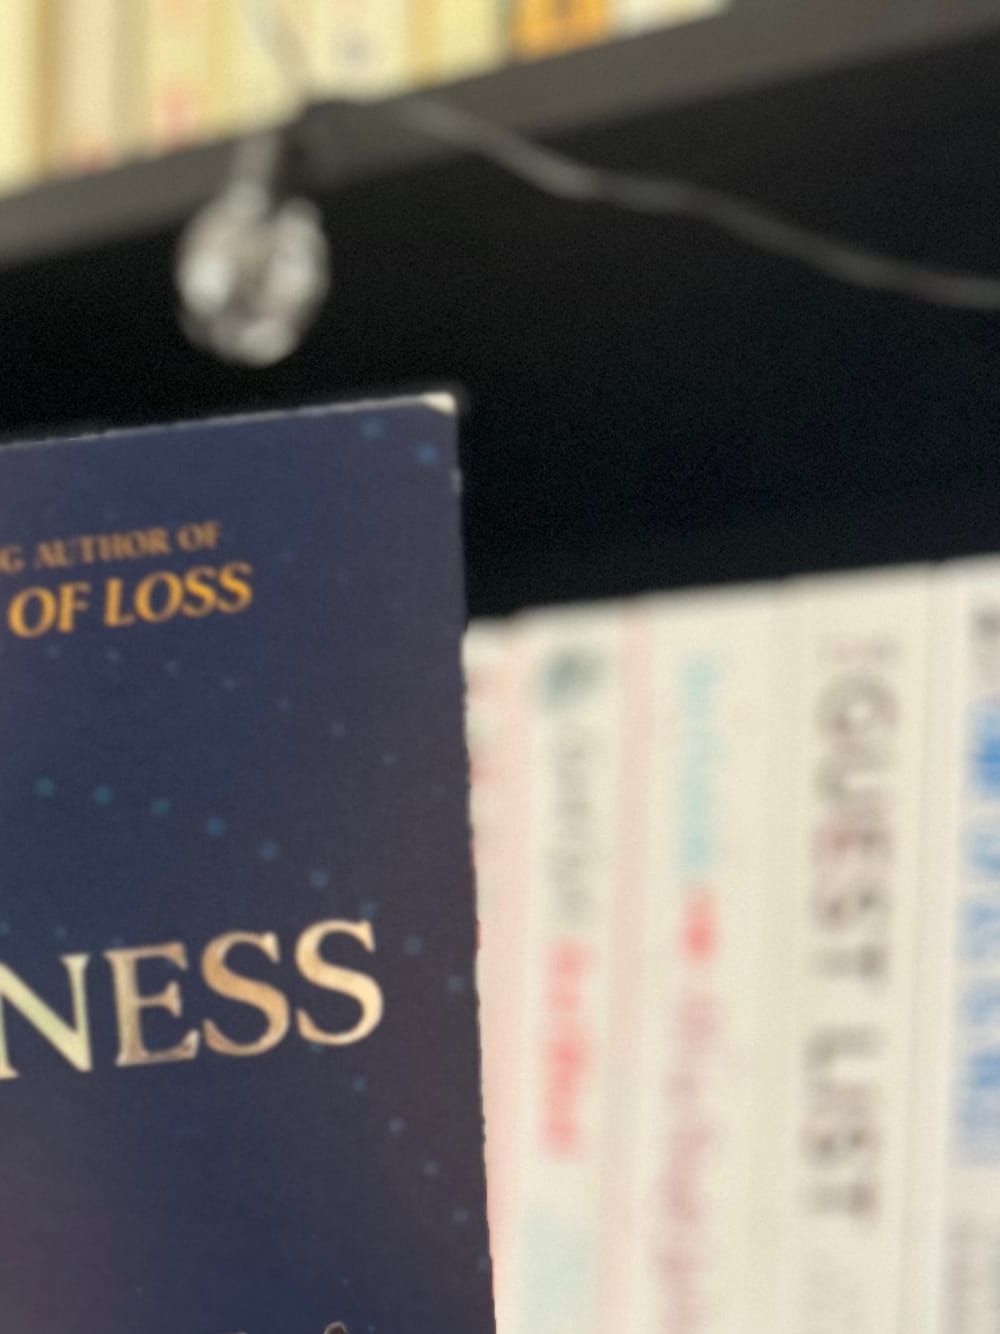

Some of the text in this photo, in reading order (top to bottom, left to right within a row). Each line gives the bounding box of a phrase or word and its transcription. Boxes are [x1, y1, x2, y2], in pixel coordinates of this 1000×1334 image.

[35, 526, 173, 569] AUTHOR
[177, 520, 222, 552] OF
[7, 581, 91, 639] OF
[104, 561, 254, 627] LOSS
